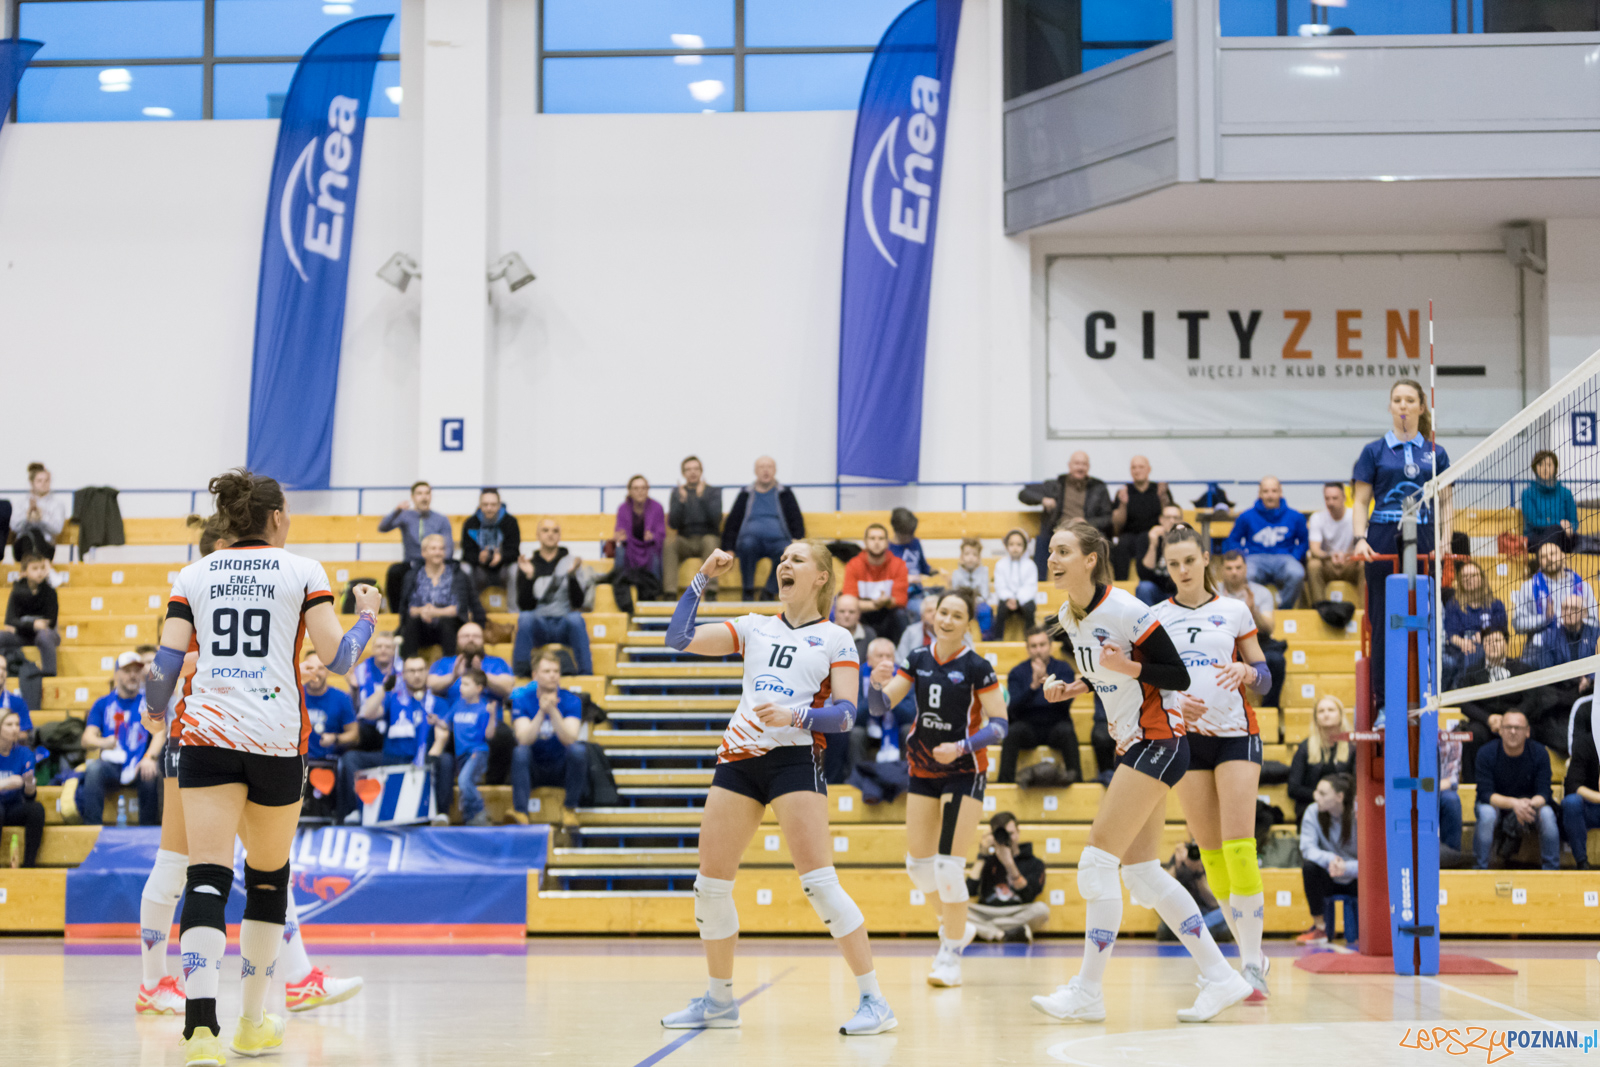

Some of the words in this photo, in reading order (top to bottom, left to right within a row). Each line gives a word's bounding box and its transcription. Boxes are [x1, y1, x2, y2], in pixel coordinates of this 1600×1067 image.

[889, 74, 941, 245] Enea
[303, 94, 360, 262] Enea
[1084, 309, 1421, 360] CITYZEN
[1286, 365, 1326, 377] KLUB
[1335, 365, 1421, 377] SPORTOWY
[444, 421, 460, 449] C
[209, 559, 280, 571] SIKORSKA
[229, 575, 257, 584] ENEA
[210, 584, 275, 600] ENERGETYK
[211, 608, 271, 658] 99
[1187, 627, 1201, 643] 7
[768, 643, 798, 669] 16
[1078, 646, 1094, 672] 11
[755, 680, 795, 697] Enea
[928, 684, 942, 708] 8
[1091, 682, 1118, 692] nea
[922, 717, 952, 731] Enea
